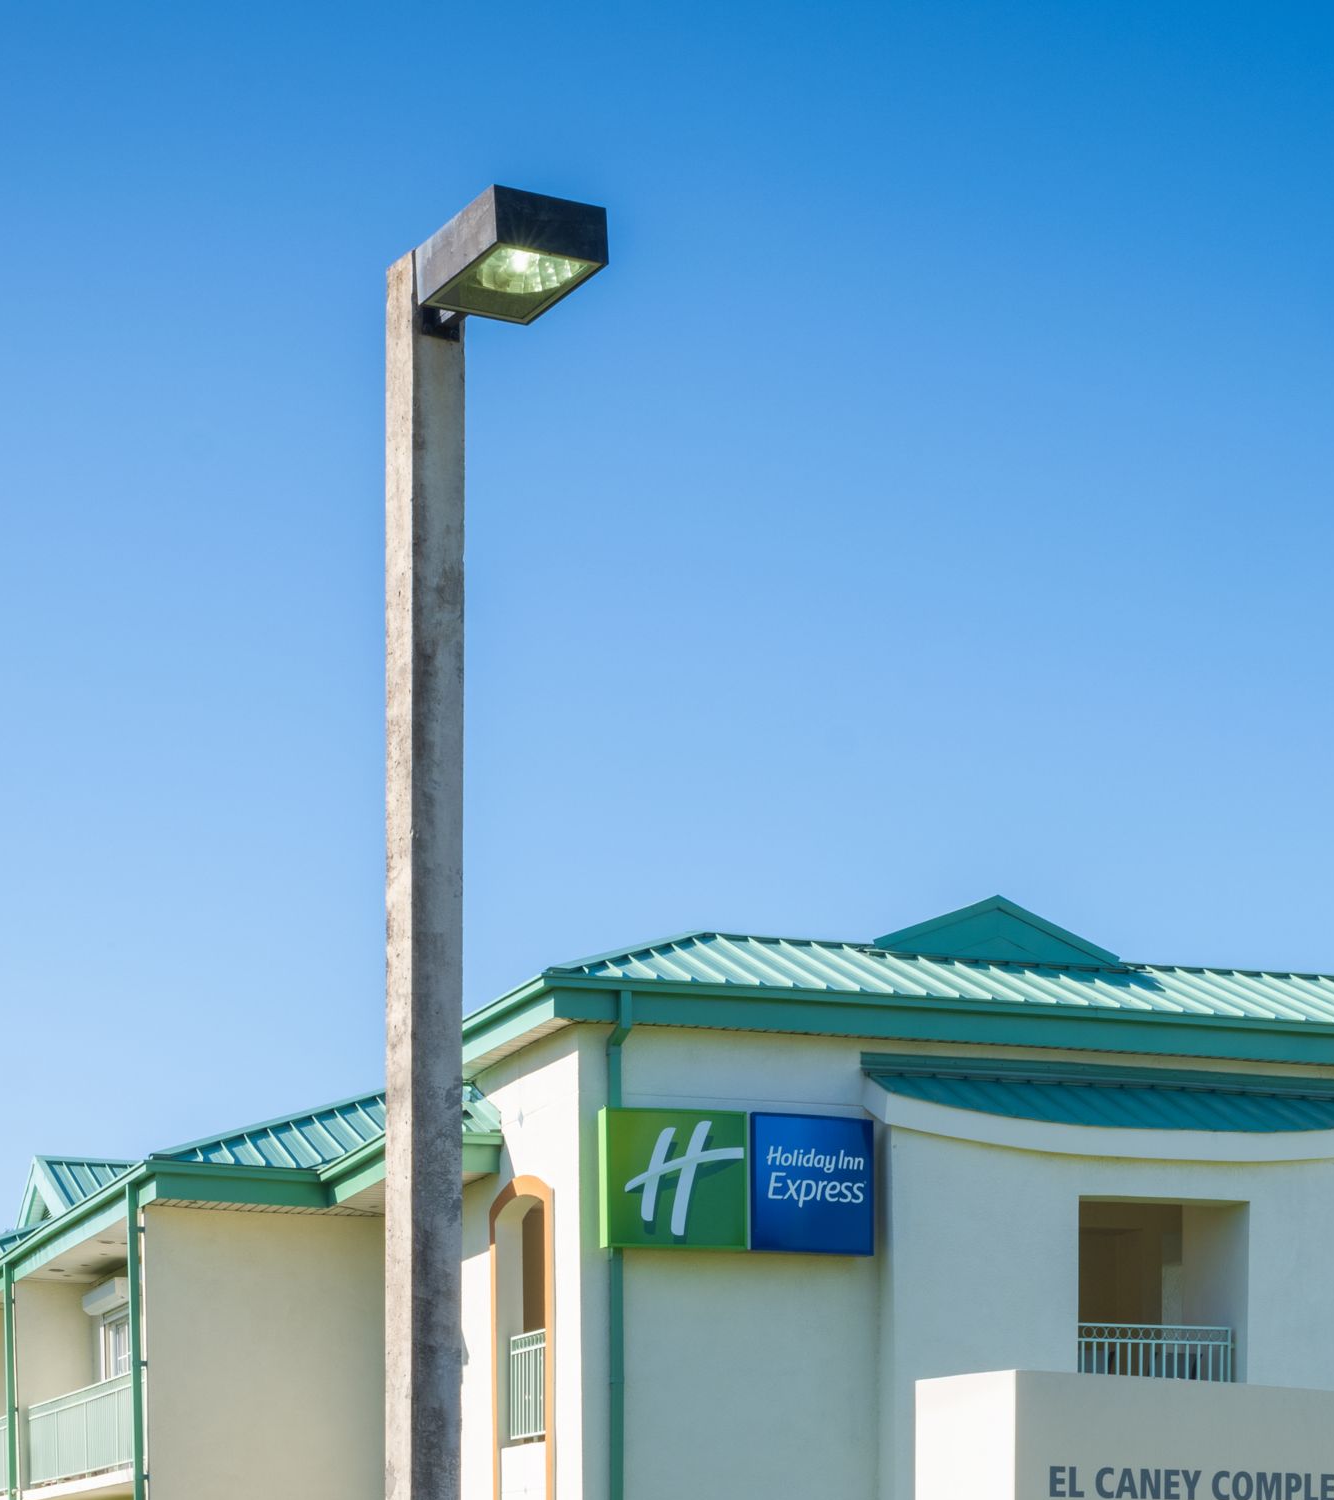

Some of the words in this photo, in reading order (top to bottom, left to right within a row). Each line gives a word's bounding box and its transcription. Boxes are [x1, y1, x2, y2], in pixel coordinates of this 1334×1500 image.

[766, 1145, 836, 1173] Holiday
[838, 1149, 864, 1170] Inn
[768, 1171, 865, 1208] Express
[1049, 1465, 1085, 1498] EL
[1095, 1467, 1202, 1500] CANEY
